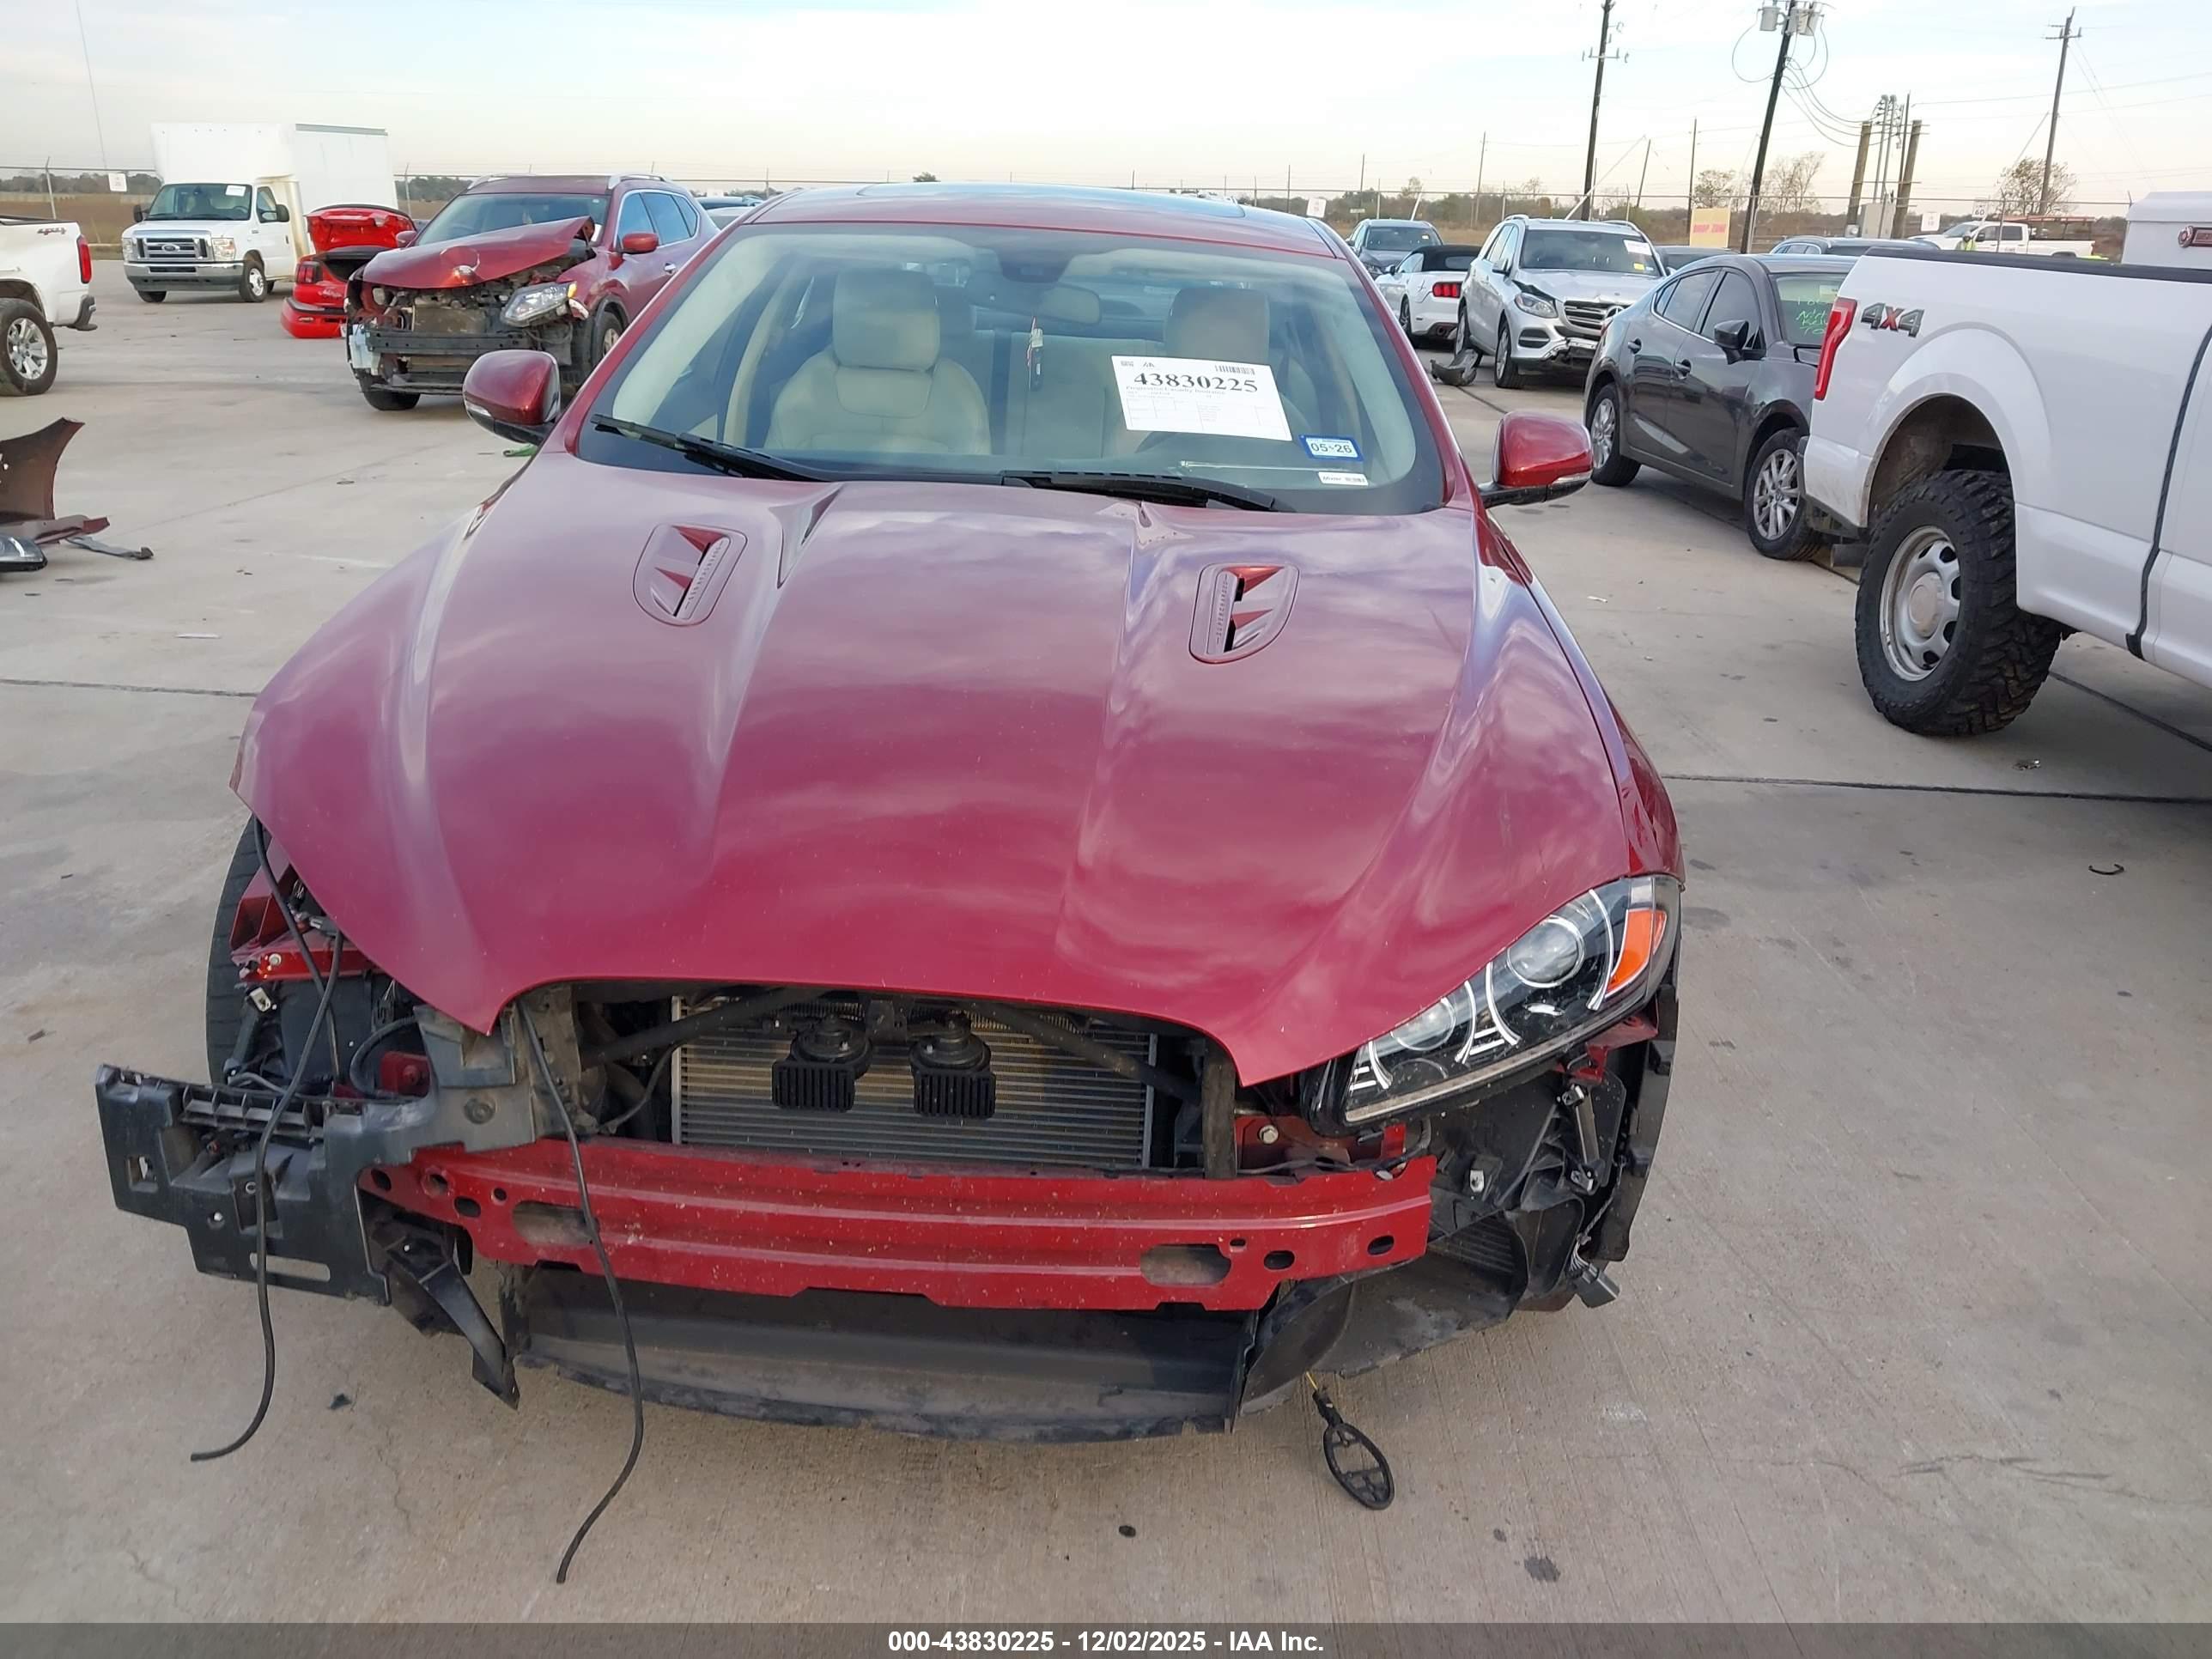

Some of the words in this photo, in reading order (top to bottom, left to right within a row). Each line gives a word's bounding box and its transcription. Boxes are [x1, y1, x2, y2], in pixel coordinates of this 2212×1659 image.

[1134, 373, 1258, 393] 43830225
[1310, 442, 1328, 453] 05
[1334, 444, 1352, 453] 26
